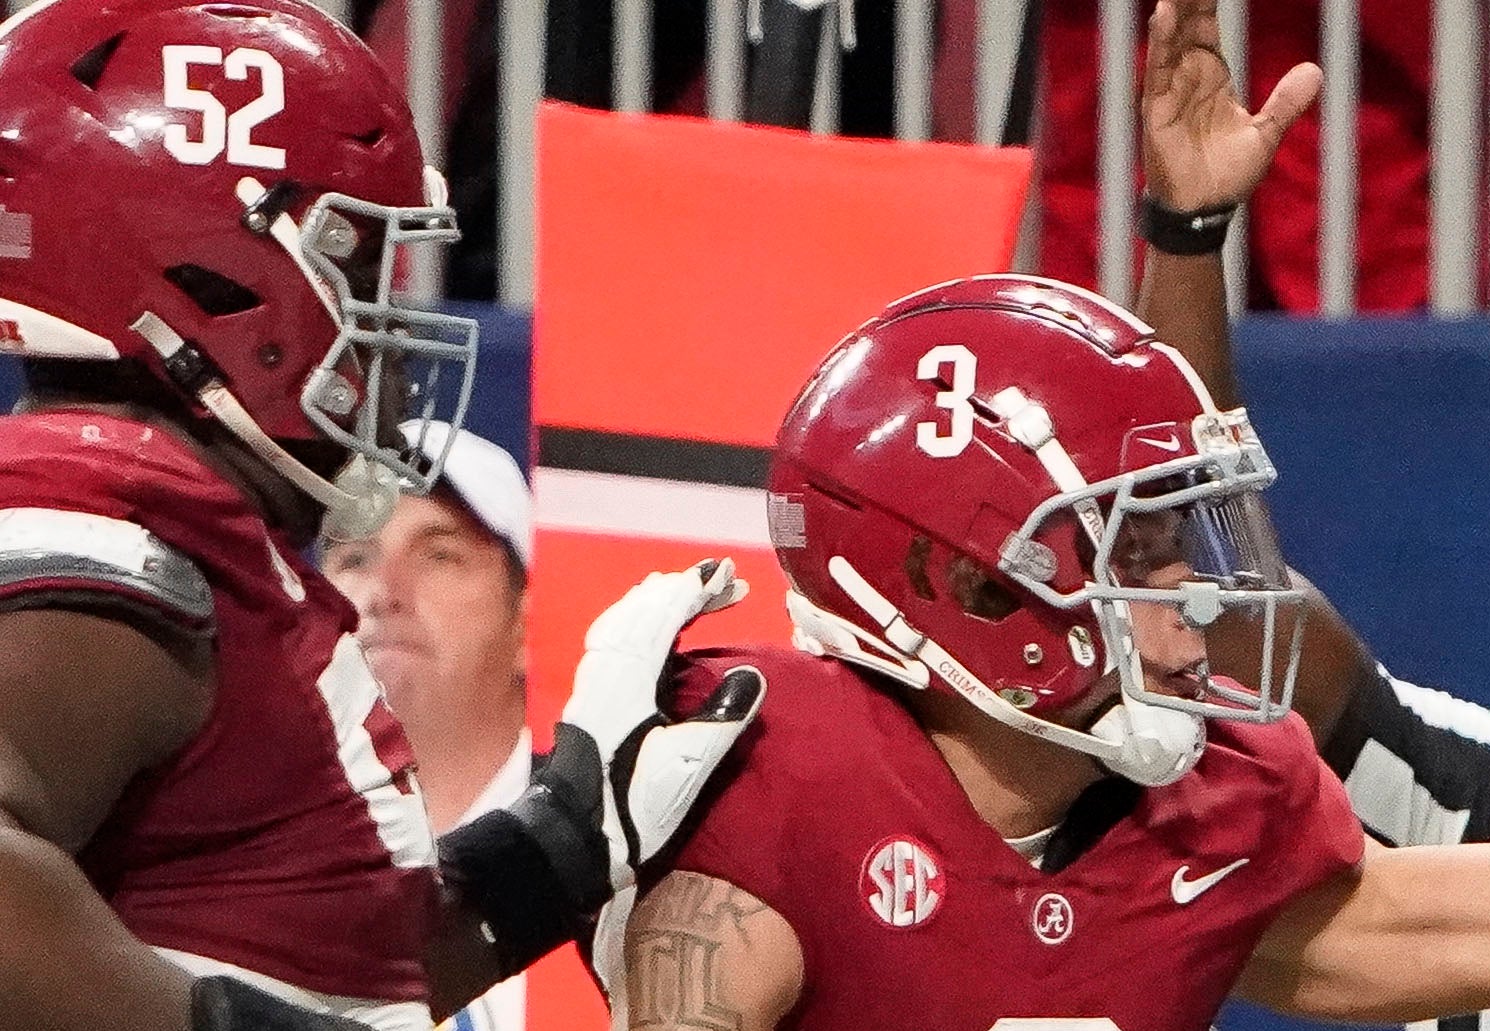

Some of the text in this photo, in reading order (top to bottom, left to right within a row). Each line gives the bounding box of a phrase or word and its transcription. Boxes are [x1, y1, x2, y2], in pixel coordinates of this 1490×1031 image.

[162, 44, 285, 169] 52
[915, 343, 978, 458] 3
[868, 840, 940, 927] SEC
